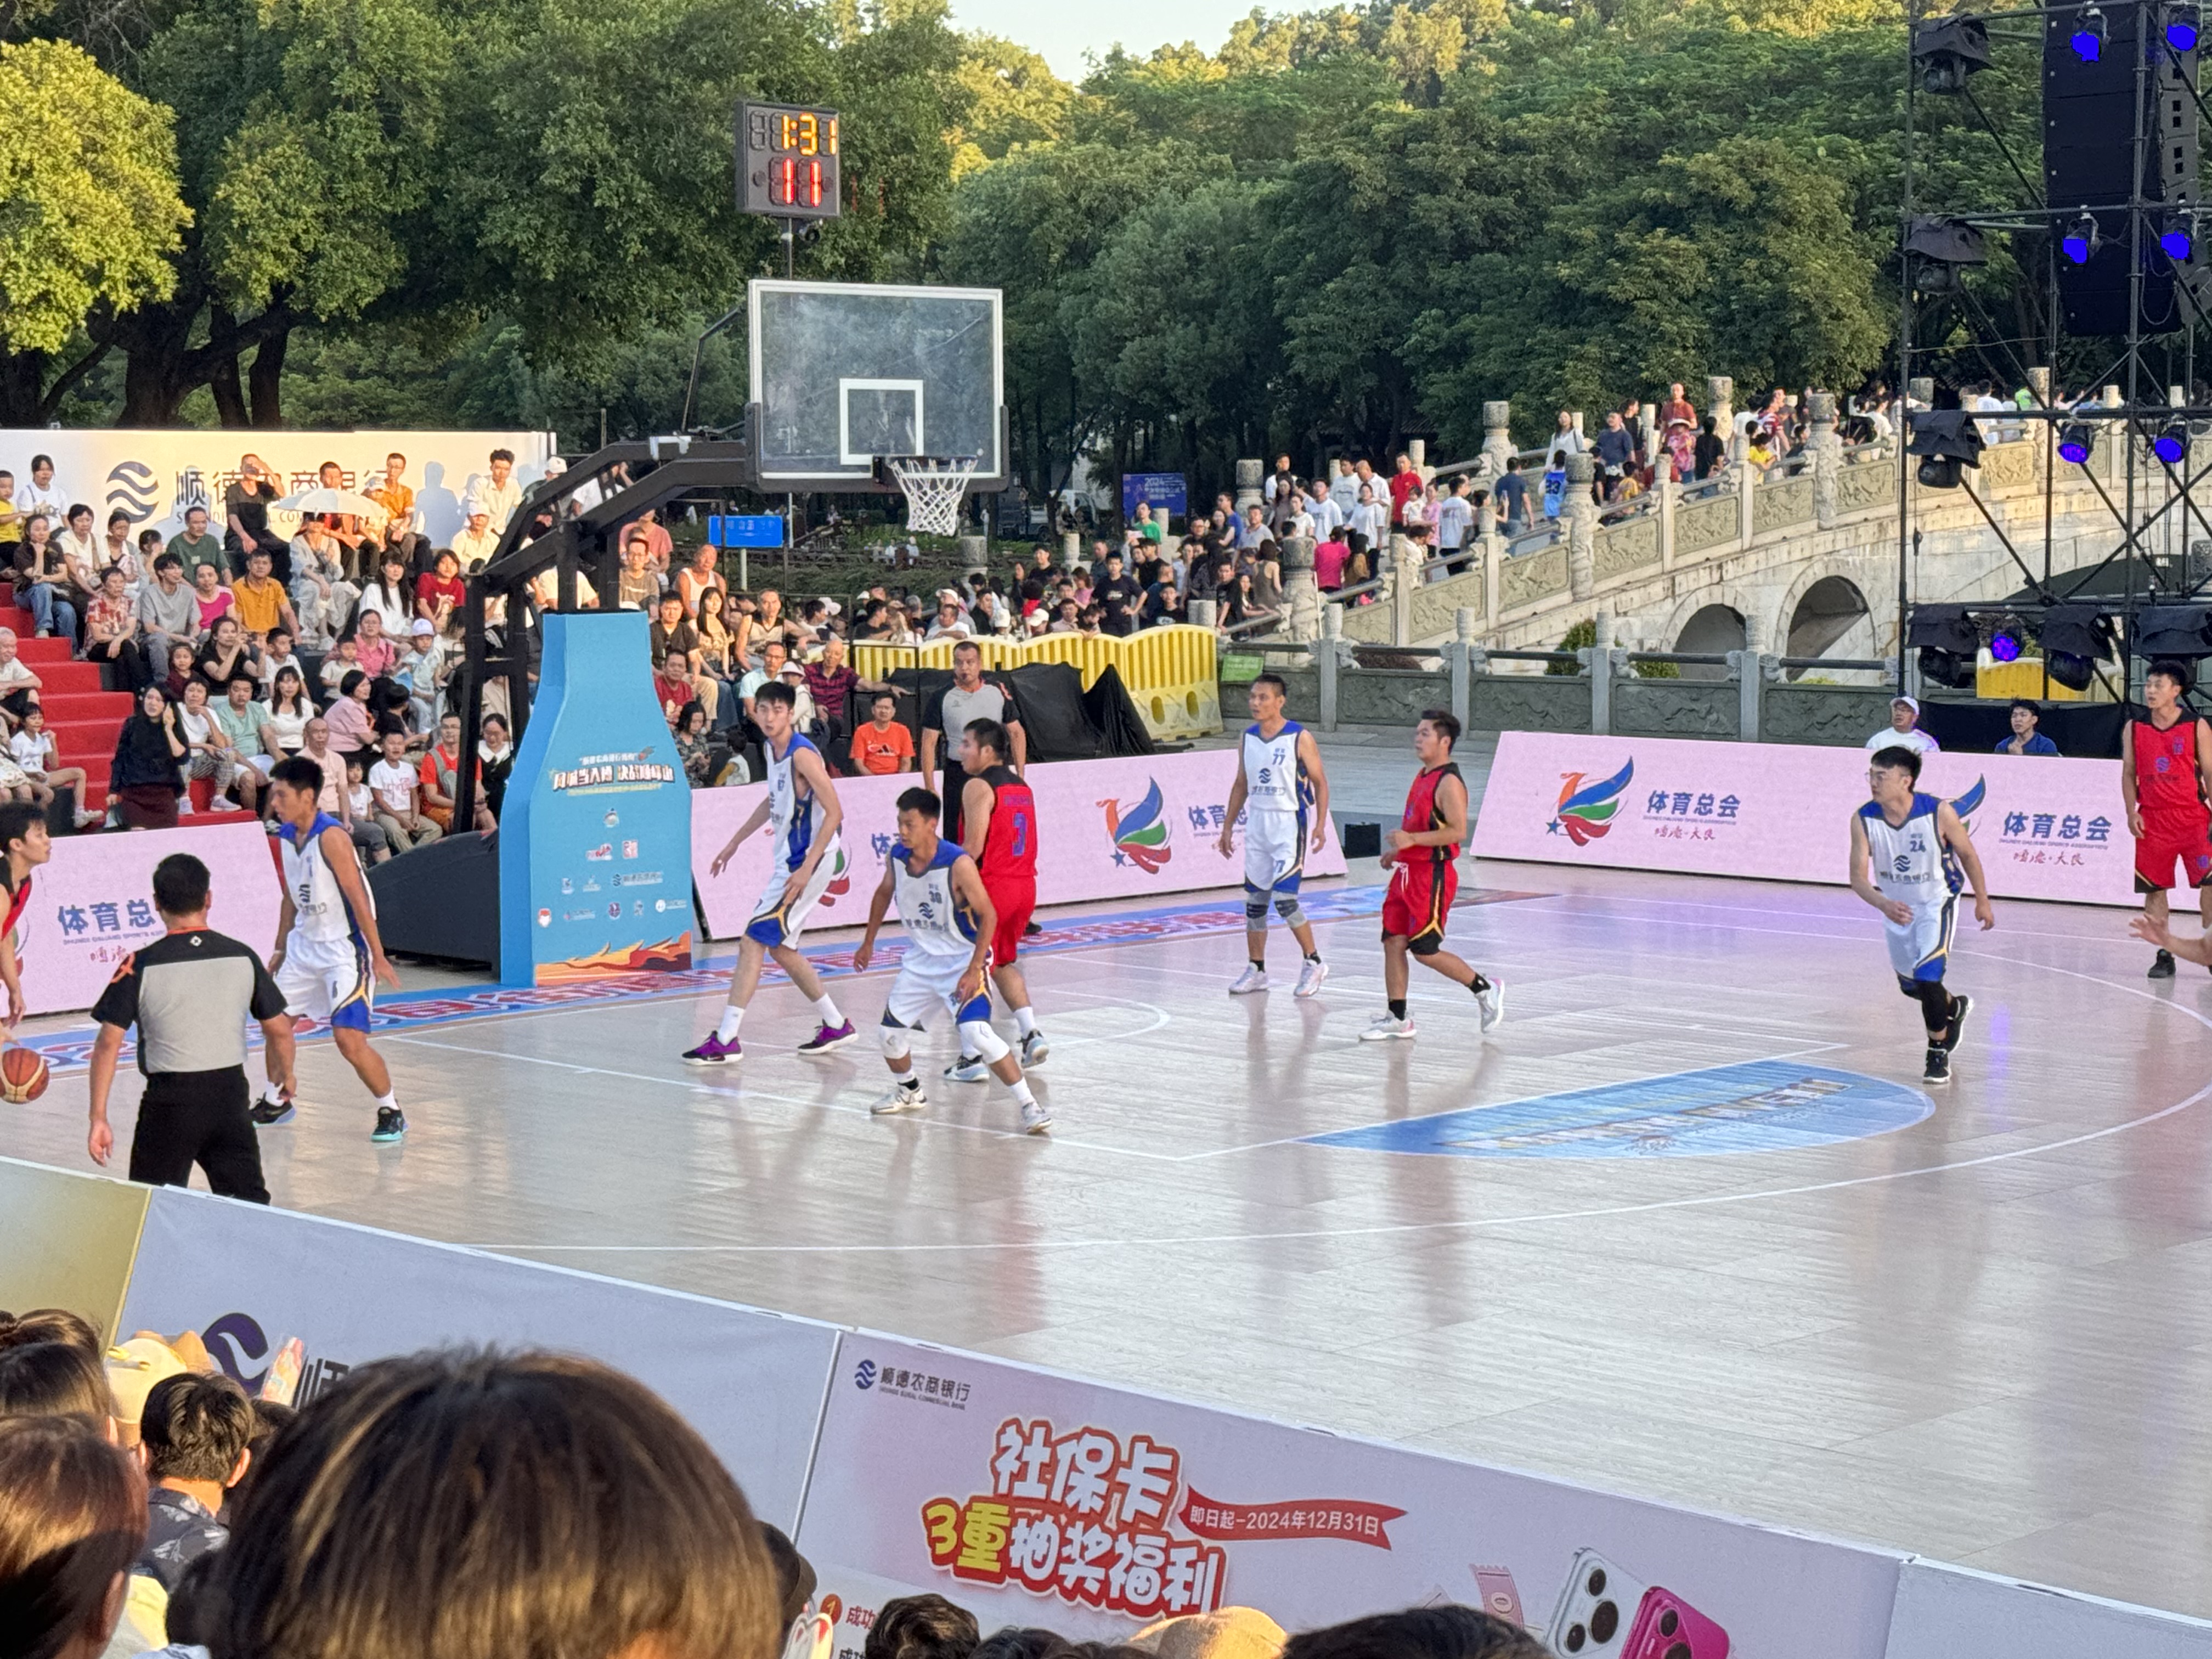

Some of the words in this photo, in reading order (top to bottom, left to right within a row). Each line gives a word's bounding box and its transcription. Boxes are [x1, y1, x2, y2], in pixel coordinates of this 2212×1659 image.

[782, 113, 837, 155] 1:31
[783, 158, 821, 207] 11
[1272, 753, 1285, 765] 77
[1647, 790, 1741, 818] 体育总会
[2003, 811, 2112, 842] 体育总会
[1910, 839, 1926, 853] 24
[58, 899, 156, 936] 体育总
[880, 1367, 971, 1401] 顺德农商银行
[995, 1423, 1174, 1524] 社保卡
[1189, 1505, 1379, 1537] 即日起-2024年12月31日
[926, 1500, 1219, 1612] 3重抽奖福利
